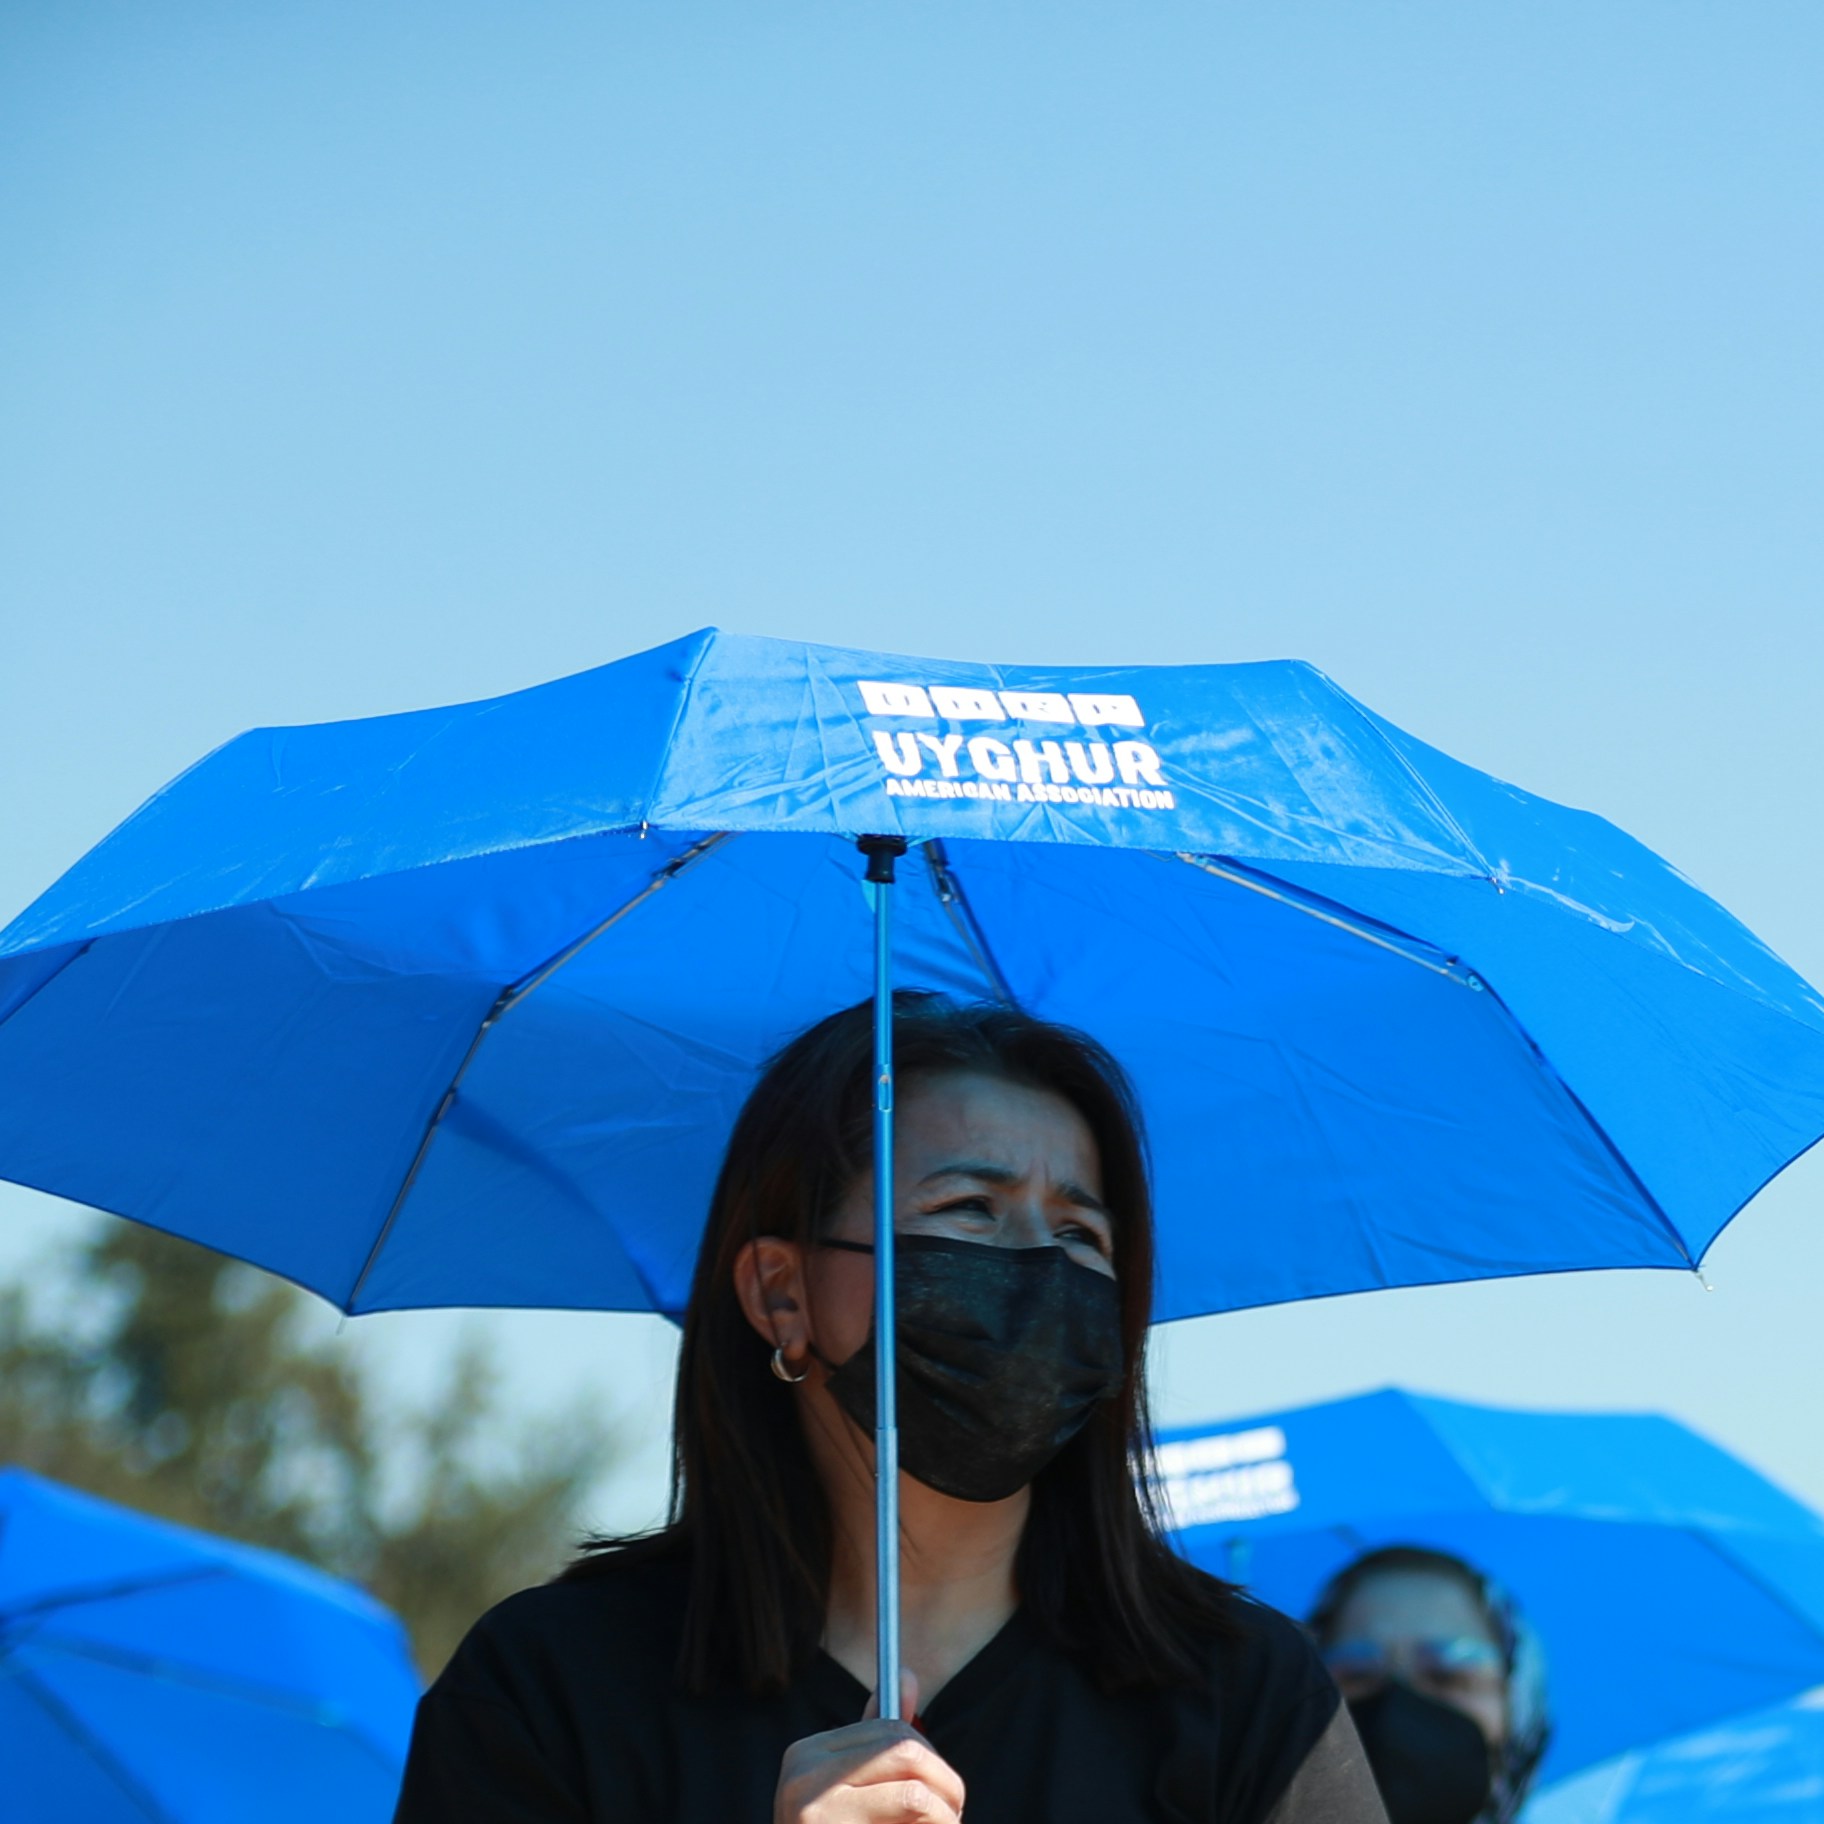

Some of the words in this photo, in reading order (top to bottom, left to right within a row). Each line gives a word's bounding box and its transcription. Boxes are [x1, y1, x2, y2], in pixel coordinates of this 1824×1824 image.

[872, 730, 1169, 786] UYGHUR
[886, 778, 1012, 802] AMERICAN
[1016, 783, 1175, 810] ASSOCIATION
